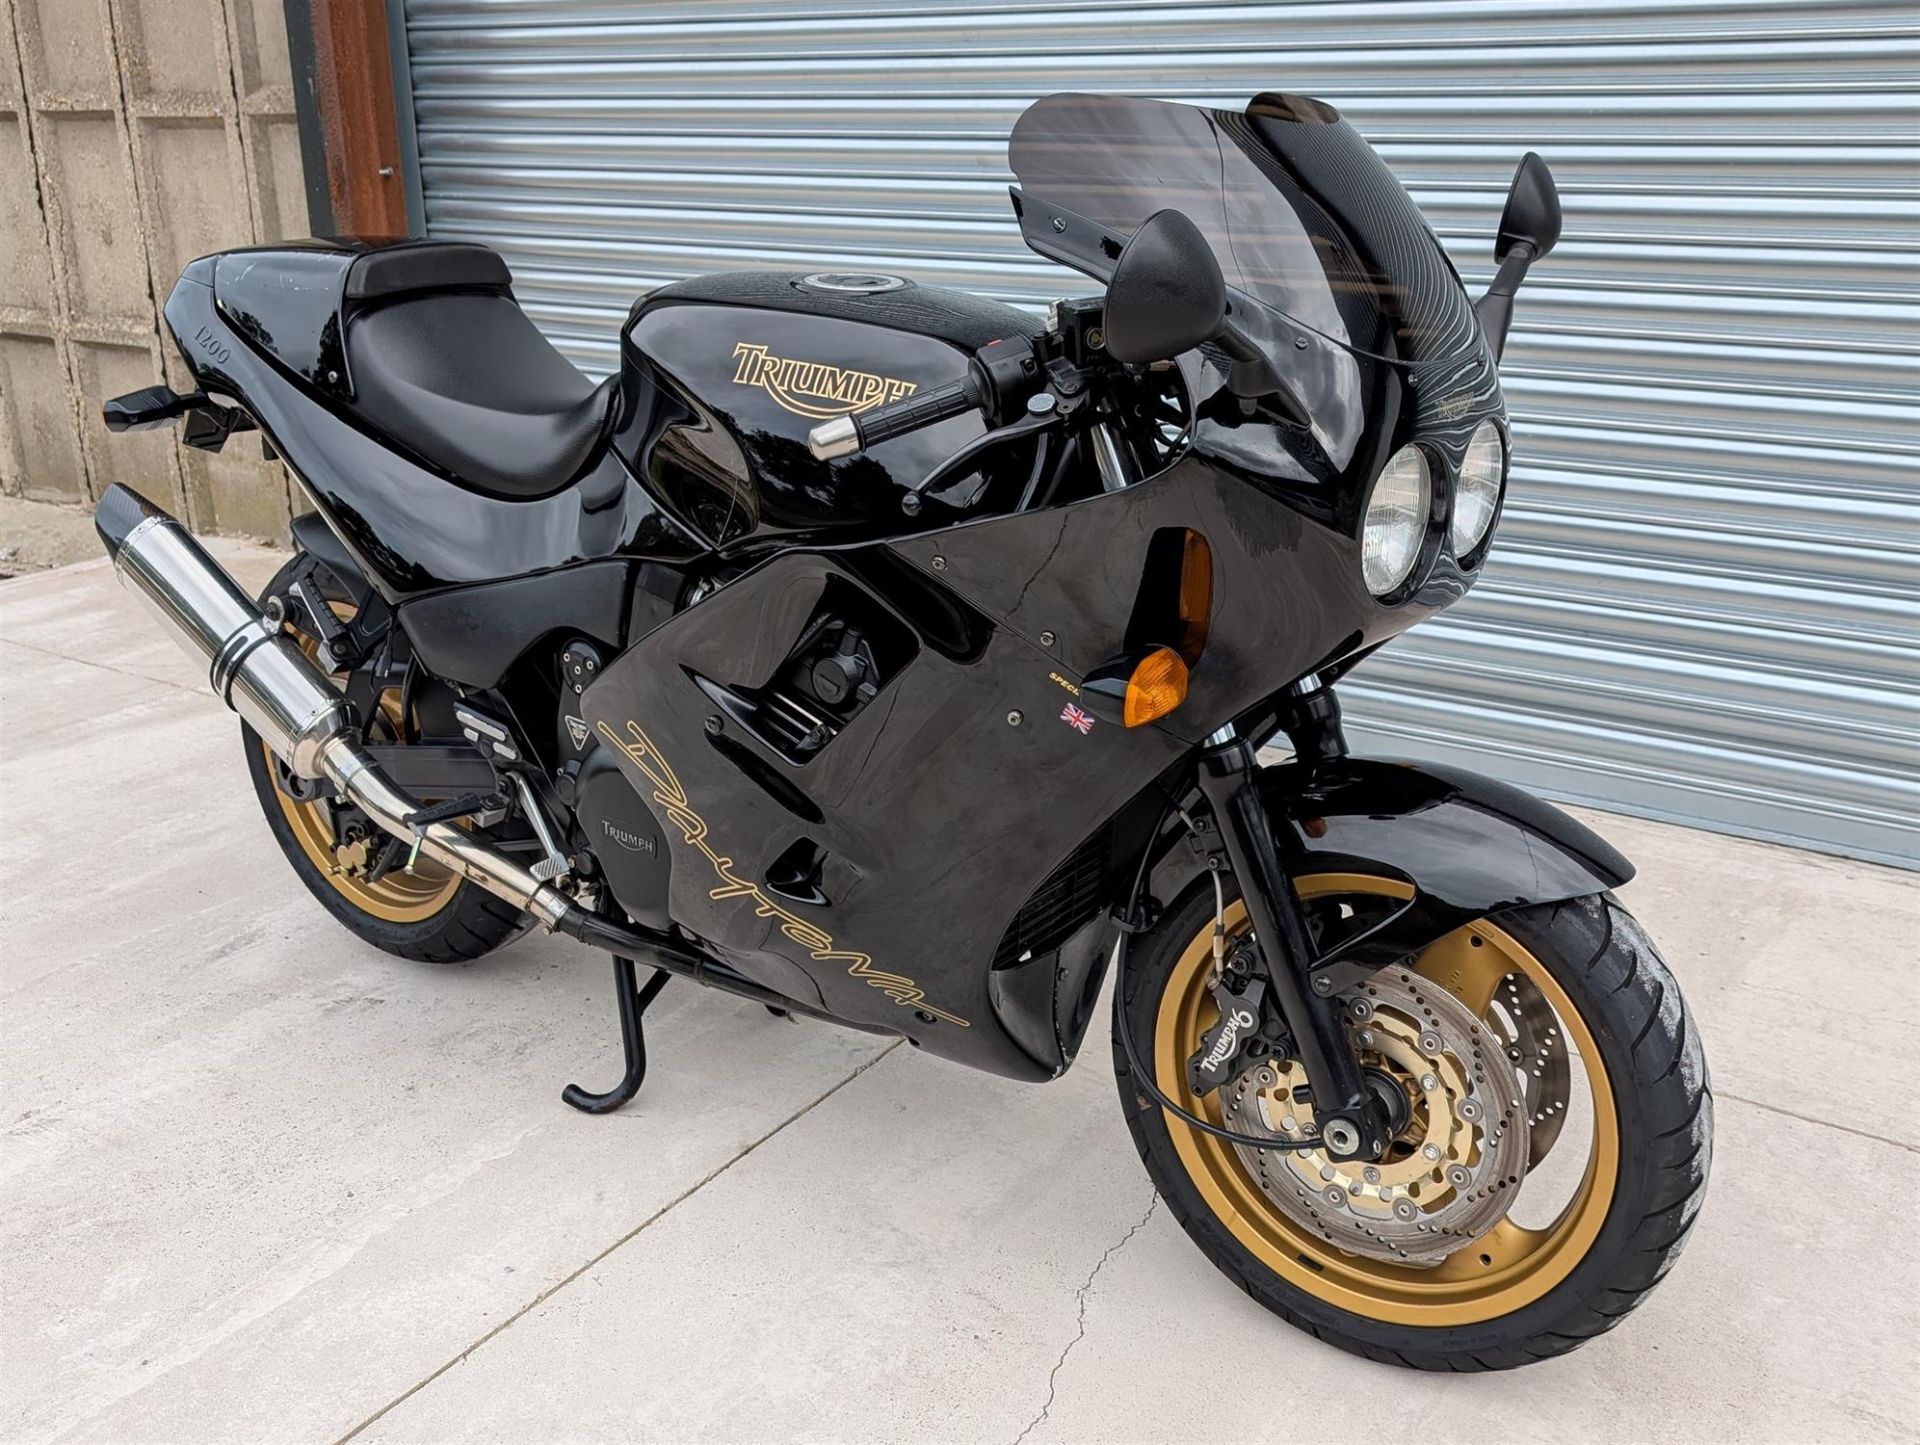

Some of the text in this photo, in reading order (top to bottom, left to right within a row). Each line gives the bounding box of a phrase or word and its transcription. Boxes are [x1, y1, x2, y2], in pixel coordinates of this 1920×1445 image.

[193, 325, 231, 364] 1200
[732, 342, 918, 420] TRIUMPH
[1049, 672, 1080, 697] SPECI
[601, 819, 653, 852] TRIUMPH
[1200, 1017, 1241, 1073] TRIUMPH
